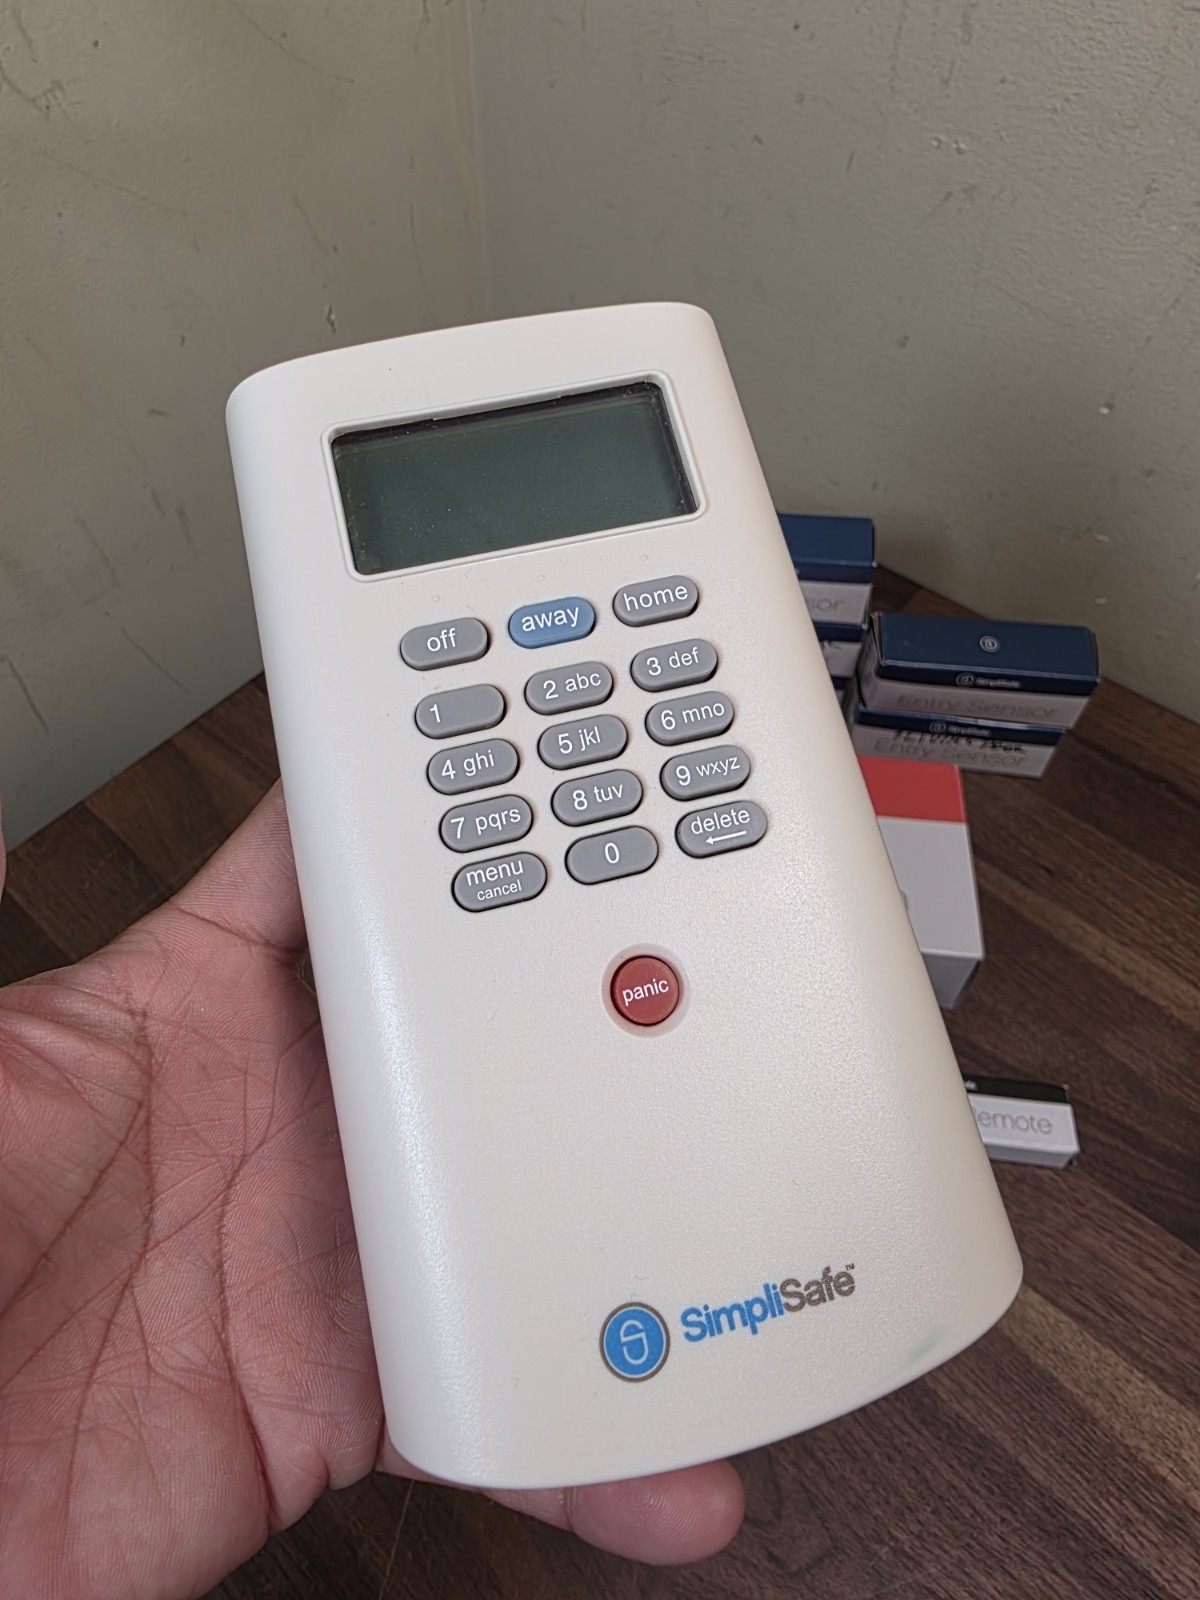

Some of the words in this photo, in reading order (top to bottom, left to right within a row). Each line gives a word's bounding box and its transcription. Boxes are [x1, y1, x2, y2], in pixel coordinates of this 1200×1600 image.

[624, 586, 688, 611] home
[522, 607, 579, 632] away
[427, 628, 456, 652] off
[646, 657, 662, 676] 3
[669, 647, 699, 669] def
[543, 680, 559, 700] 2
[565, 672, 601, 692] abc
[430, 703, 441, 723] 1
[661, 709, 676, 730] 6
[682, 703, 725, 723] mno
[558, 733, 573, 754] 5
[578, 726, 601, 751] jkl
[441, 759, 456, 780] 4
[463, 750, 495, 776] ghi
[676, 765, 691, 786] 9
[696, 757, 741, 776] wxyz
[572, 790, 588, 811] 8
[593, 784, 623, 802] tuv
[450, 817, 465, 839] 7
[475, 808, 521, 835] pqrs
[690, 809, 750, 835] delete
[604, 842, 620, 864] 0
[466, 860, 524, 886] menu
[477, 879, 522, 901] cancel
[622, 978, 669, 1006] panic
